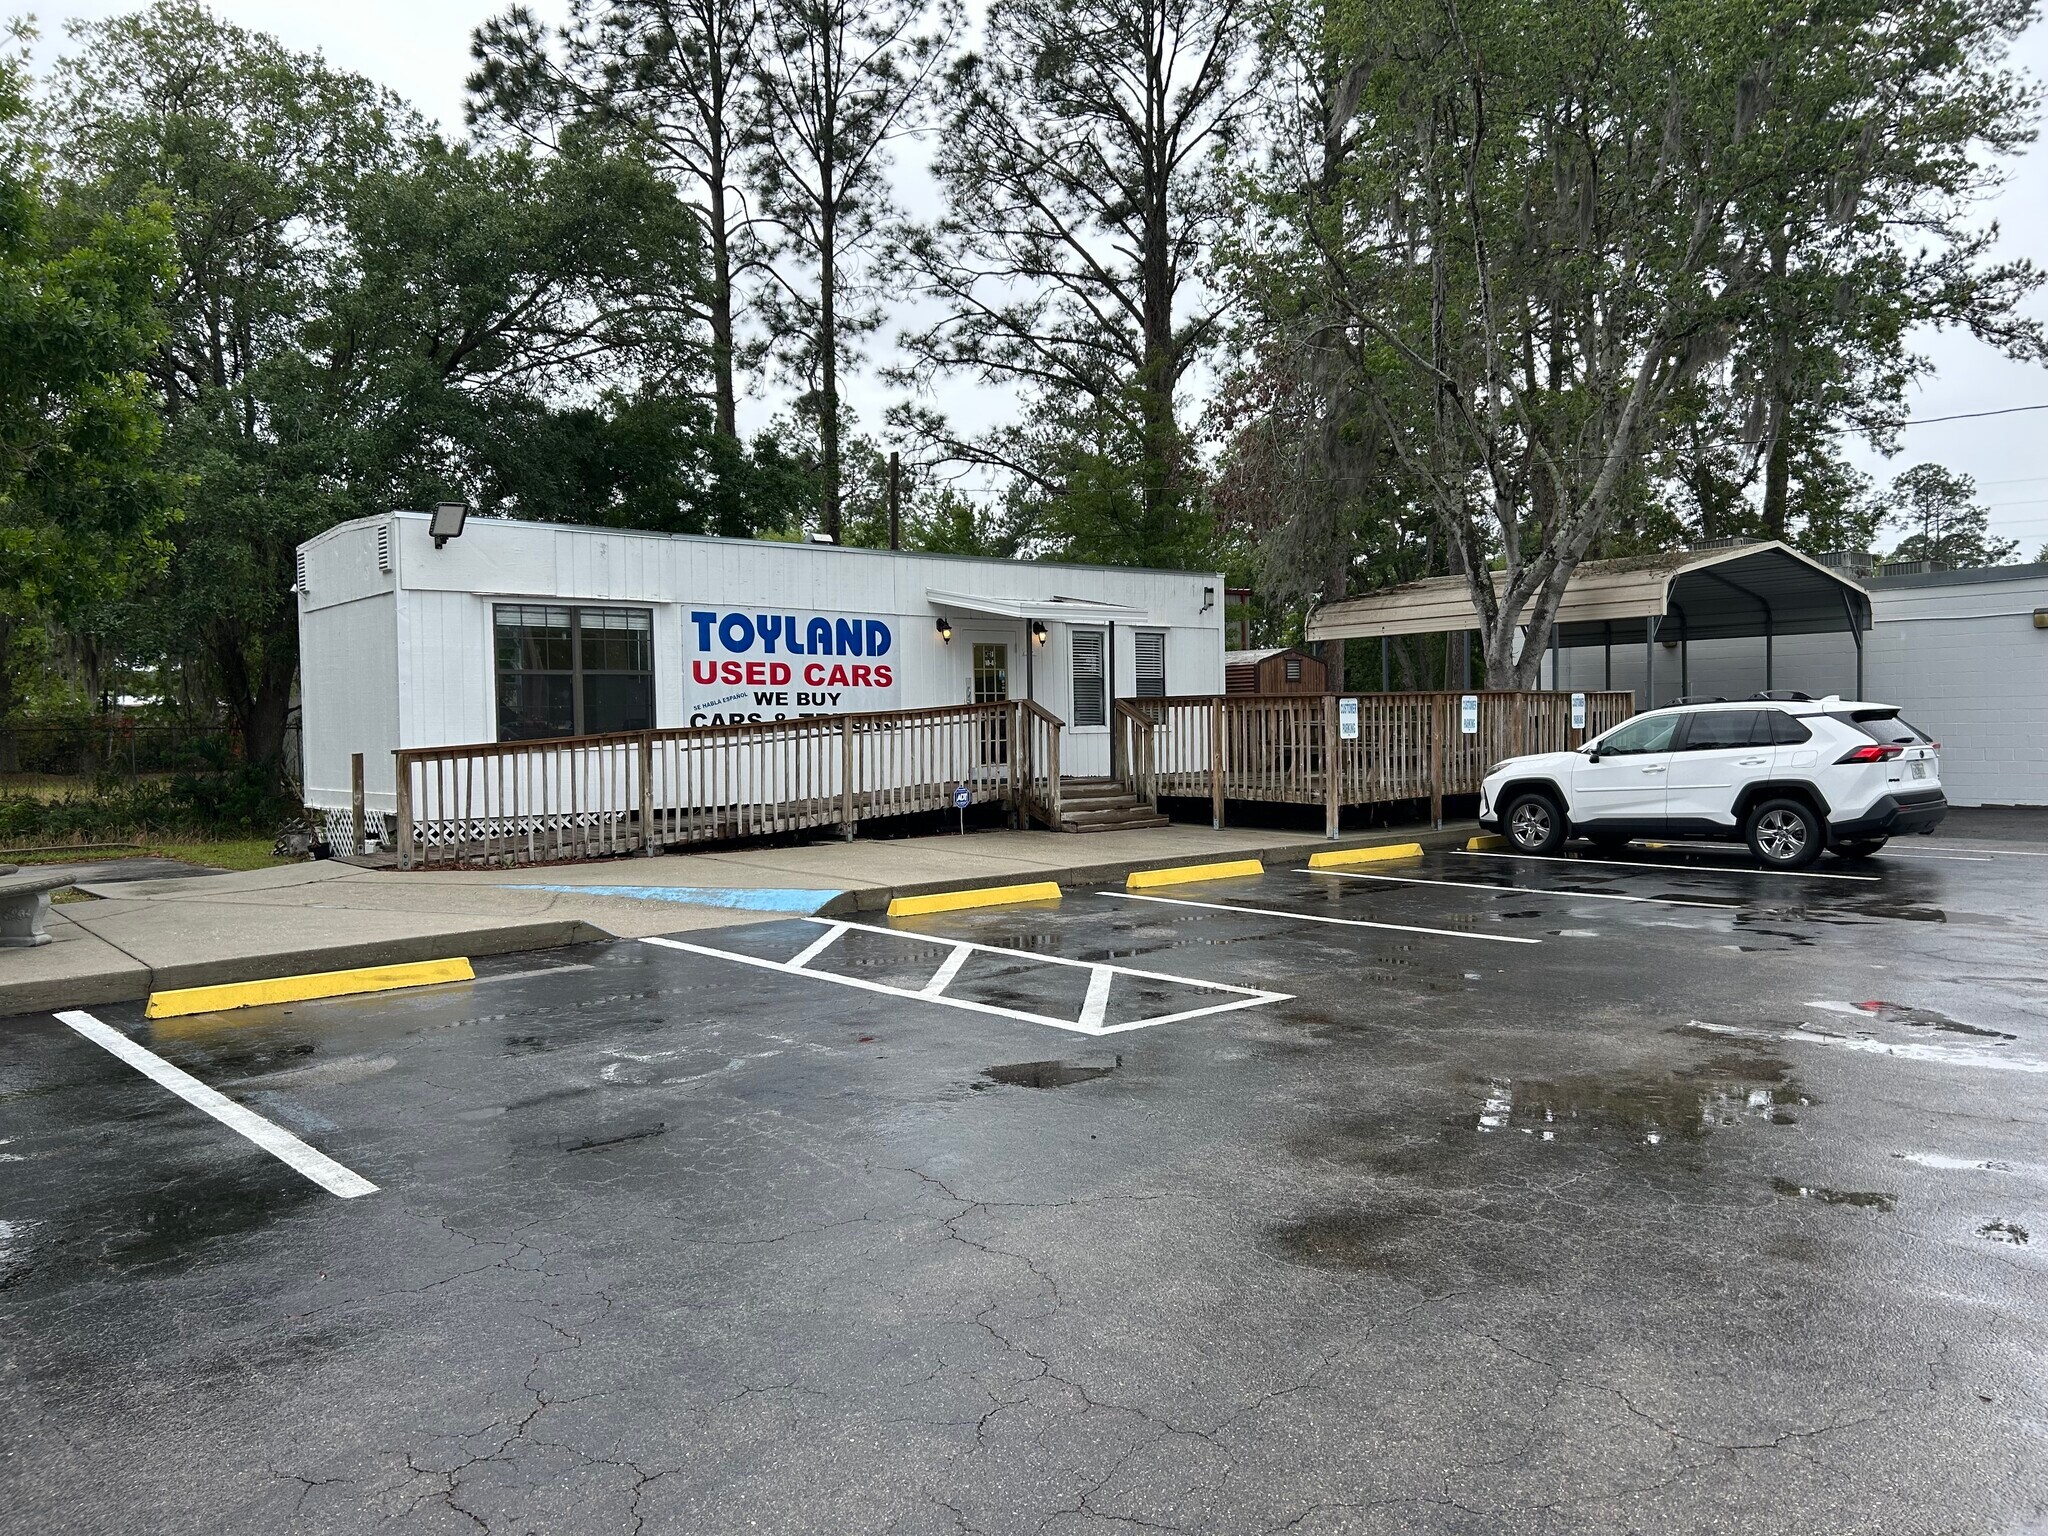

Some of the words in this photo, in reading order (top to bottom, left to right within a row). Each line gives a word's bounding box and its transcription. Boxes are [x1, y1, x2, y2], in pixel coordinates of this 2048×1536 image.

[691, 611, 892, 657] TOYLAND
[692, 660, 791, 686] USED
[804, 663, 893, 688] CARS
[702, 699, 722, 709] HABLA
[722, 691, 748, 703] ESPAÑOL
[753, 692, 789, 706] WE
[796, 692, 841, 706] BUY
[690, 713, 762, 728] CARS
[956, 793, 967, 801] ADT
